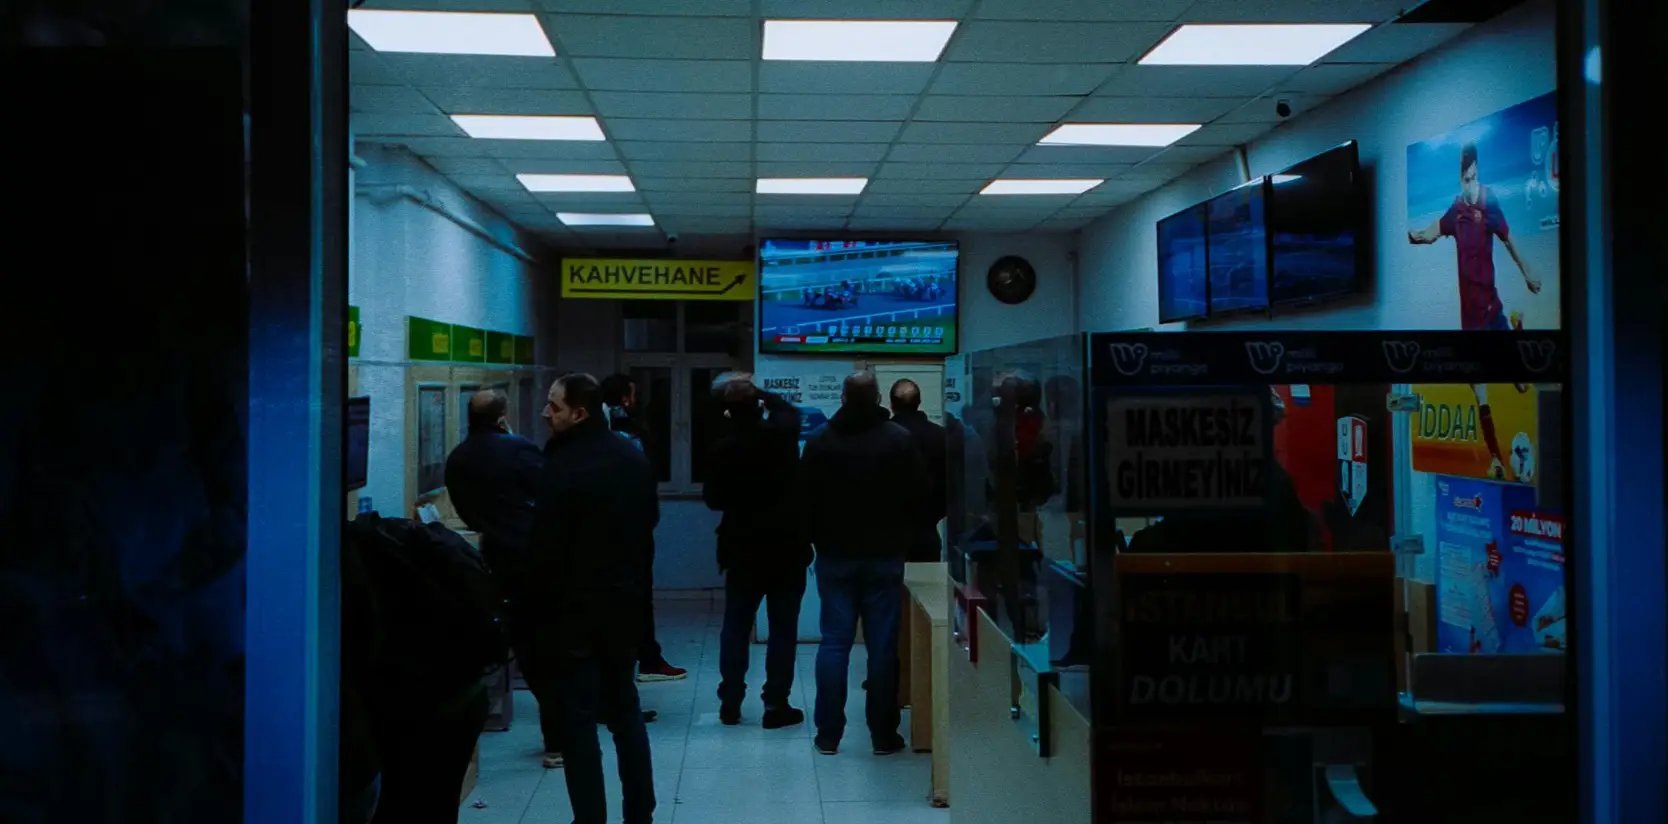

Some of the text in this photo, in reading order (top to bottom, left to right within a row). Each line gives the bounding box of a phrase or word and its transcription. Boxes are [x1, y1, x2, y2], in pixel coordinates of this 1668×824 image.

[568, 265, 722, 286] KAHVEHANE
[1125, 399, 1255, 447] MASKESİZ
[1117, 450, 1265, 500] GİRMEYİNİZ
[1510, 514, 1523, 532] 20
[1523, 512, 1562, 539] MİLYON
[1168, 633, 1248, 665] KART
[1128, 672, 1295, 706] DOLUMU
